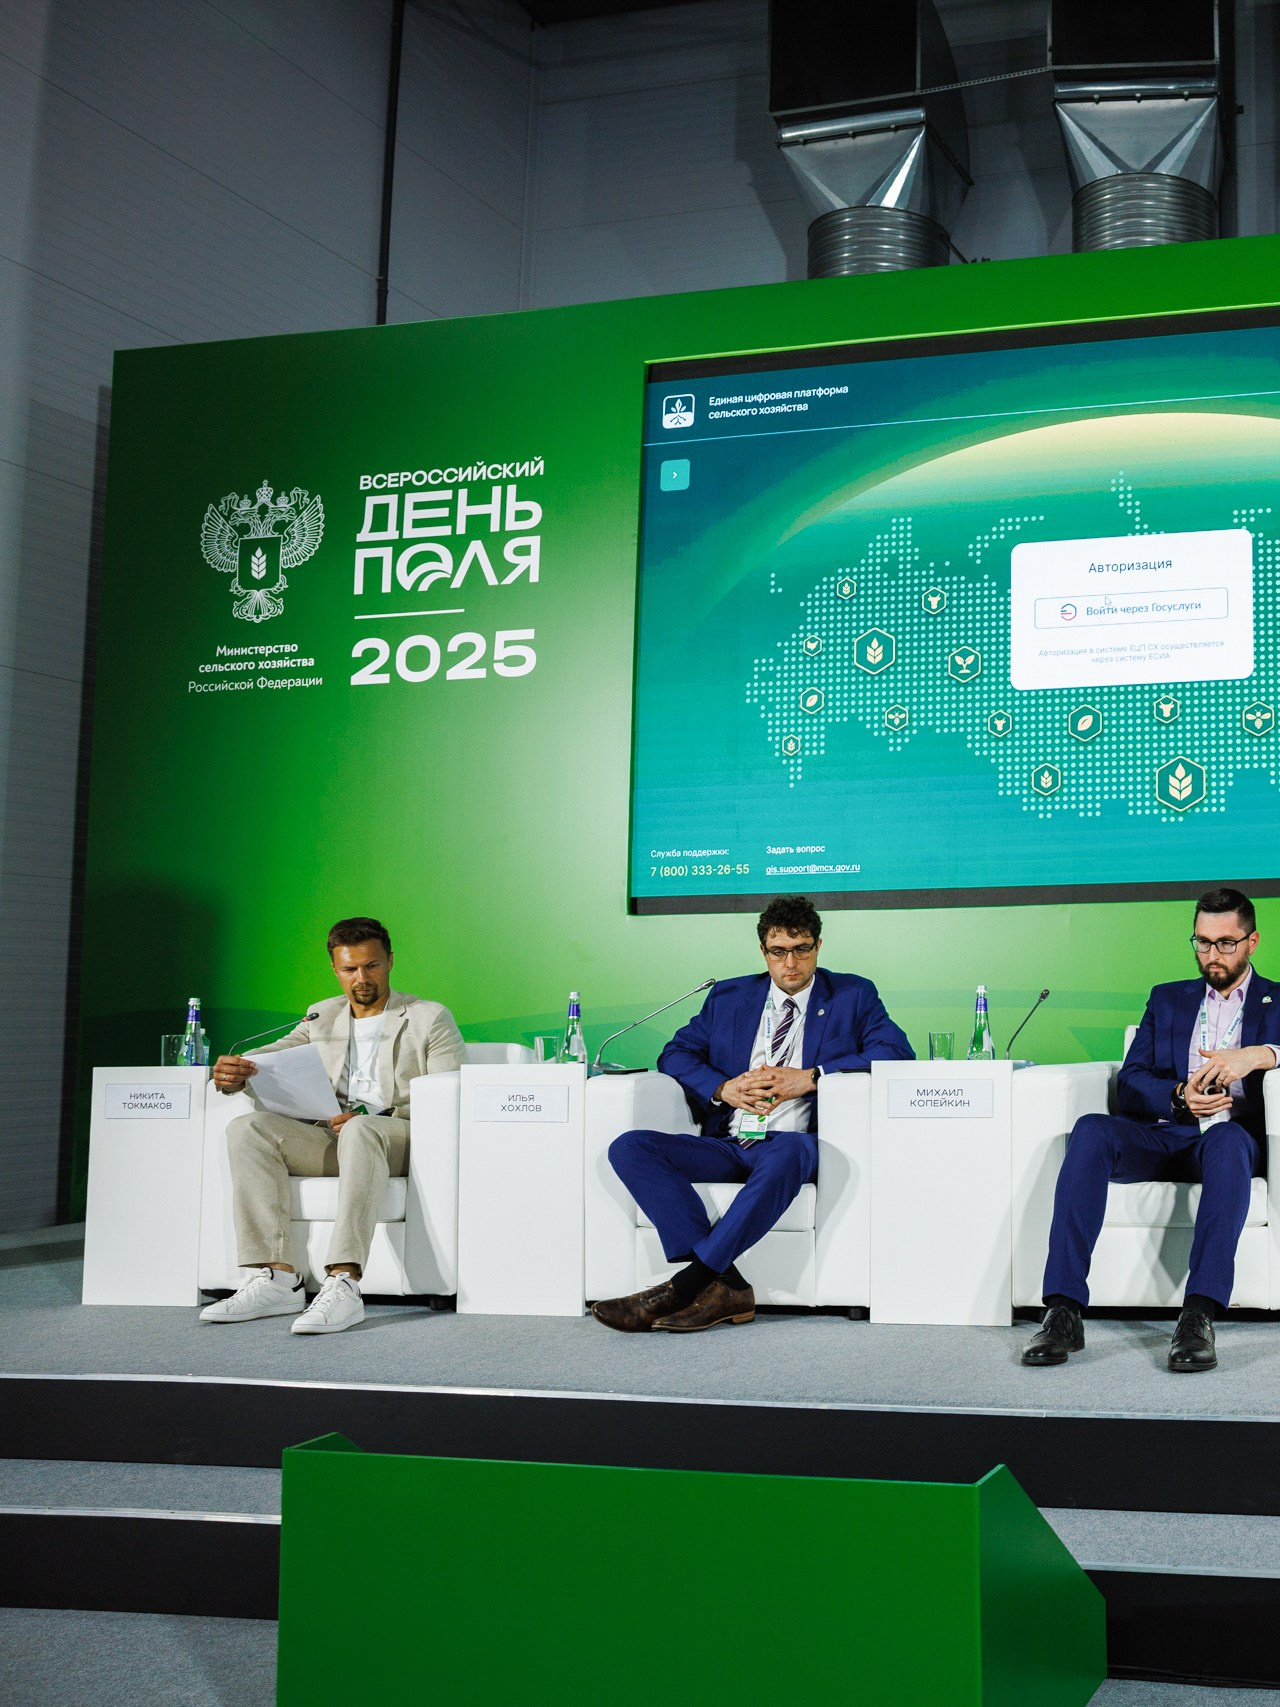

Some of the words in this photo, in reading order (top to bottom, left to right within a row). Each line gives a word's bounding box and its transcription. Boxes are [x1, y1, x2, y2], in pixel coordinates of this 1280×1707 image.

[709, 393, 743, 407] Единая
[745, 390, 793, 404] цифровая
[794, 385, 849, 399] платформа
[708, 406, 757, 419] сельского
[759, 402, 808, 416] хозяйства
[359, 456, 544, 491] ВСЕРОССИЙСКИЙ
[356, 484, 543, 542] ДЕНЬ
[353, 535, 541, 595] ПОЛЯ
[1088, 559, 1172, 574] Авторизация
[1086, 605, 1117, 616] Войти
[1120, 603, 1149, 616] через
[1151, 601, 1201, 614] Госуслуги
[216, 642, 299, 658] Министерство
[350, 628, 537, 686] 2025
[1039, 647, 1088, 658] Авторизация
[198, 658, 256, 673] сельского
[258, 655, 315, 671] хозяйства
[188, 677, 254, 693] Российской
[256, 675, 323, 691] Федерации
[650, 849, 681, 860] Служба
[683, 848, 730, 858] поддержки:
[766, 845, 794, 855] Задать
[796, 845, 826, 854] вопрос
[650, 867, 656, 876] 7
[660, 865, 689, 877] (800)
[691, 864, 750, 876] 333-26-55
[766, 864, 861, 875] gis.support@mcx.gov.ru
[129, 1092, 166, 1100] НИКИТА
[508, 1094, 535, 1102] ИЛЬЯ
[916, 1089, 964, 1097] МИХАИЛ
[122, 1102, 172, 1110] ТОКМАКОВ
[501, 1104, 542, 1112] ХОХЛОВ
[910, 1098, 970, 1107] КОПЕЙКИН
